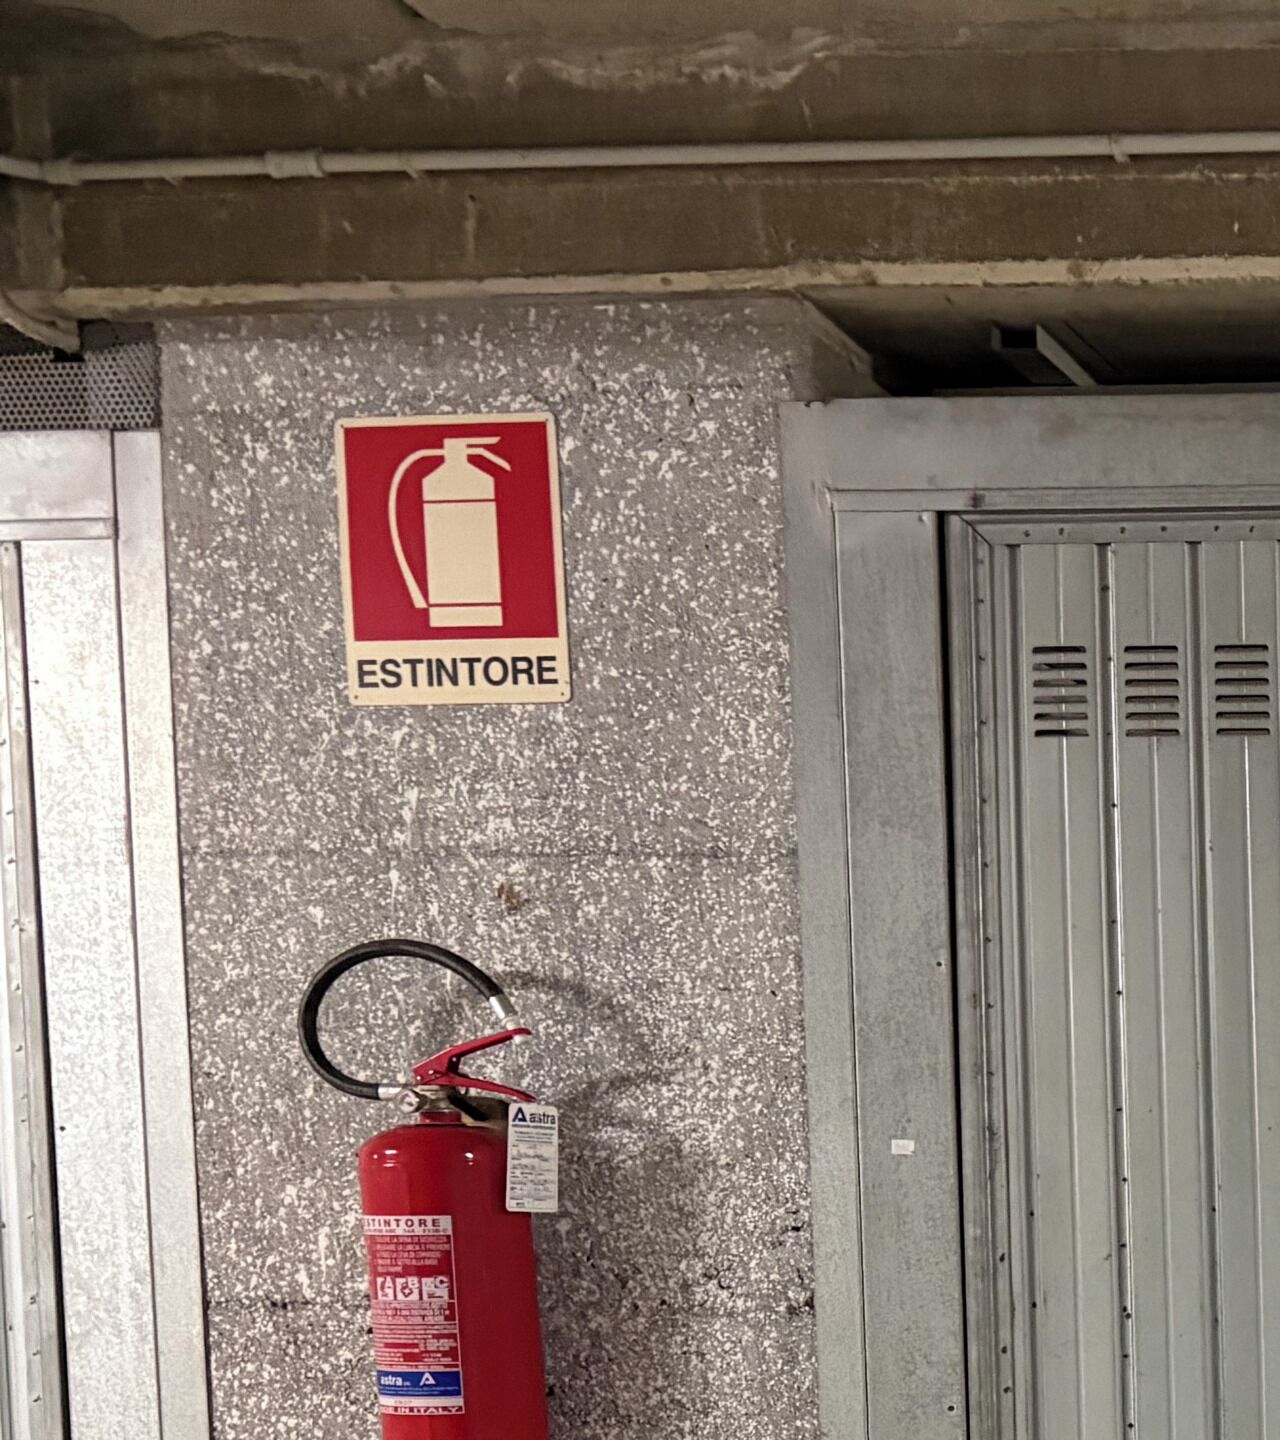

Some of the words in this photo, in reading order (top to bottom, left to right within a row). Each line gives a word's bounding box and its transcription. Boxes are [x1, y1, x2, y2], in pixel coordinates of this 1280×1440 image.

[357, 656, 559, 689] ESTINTORE
[529, 1112, 556, 1125] astra
[363, 1218, 441, 1228] STINTORE
